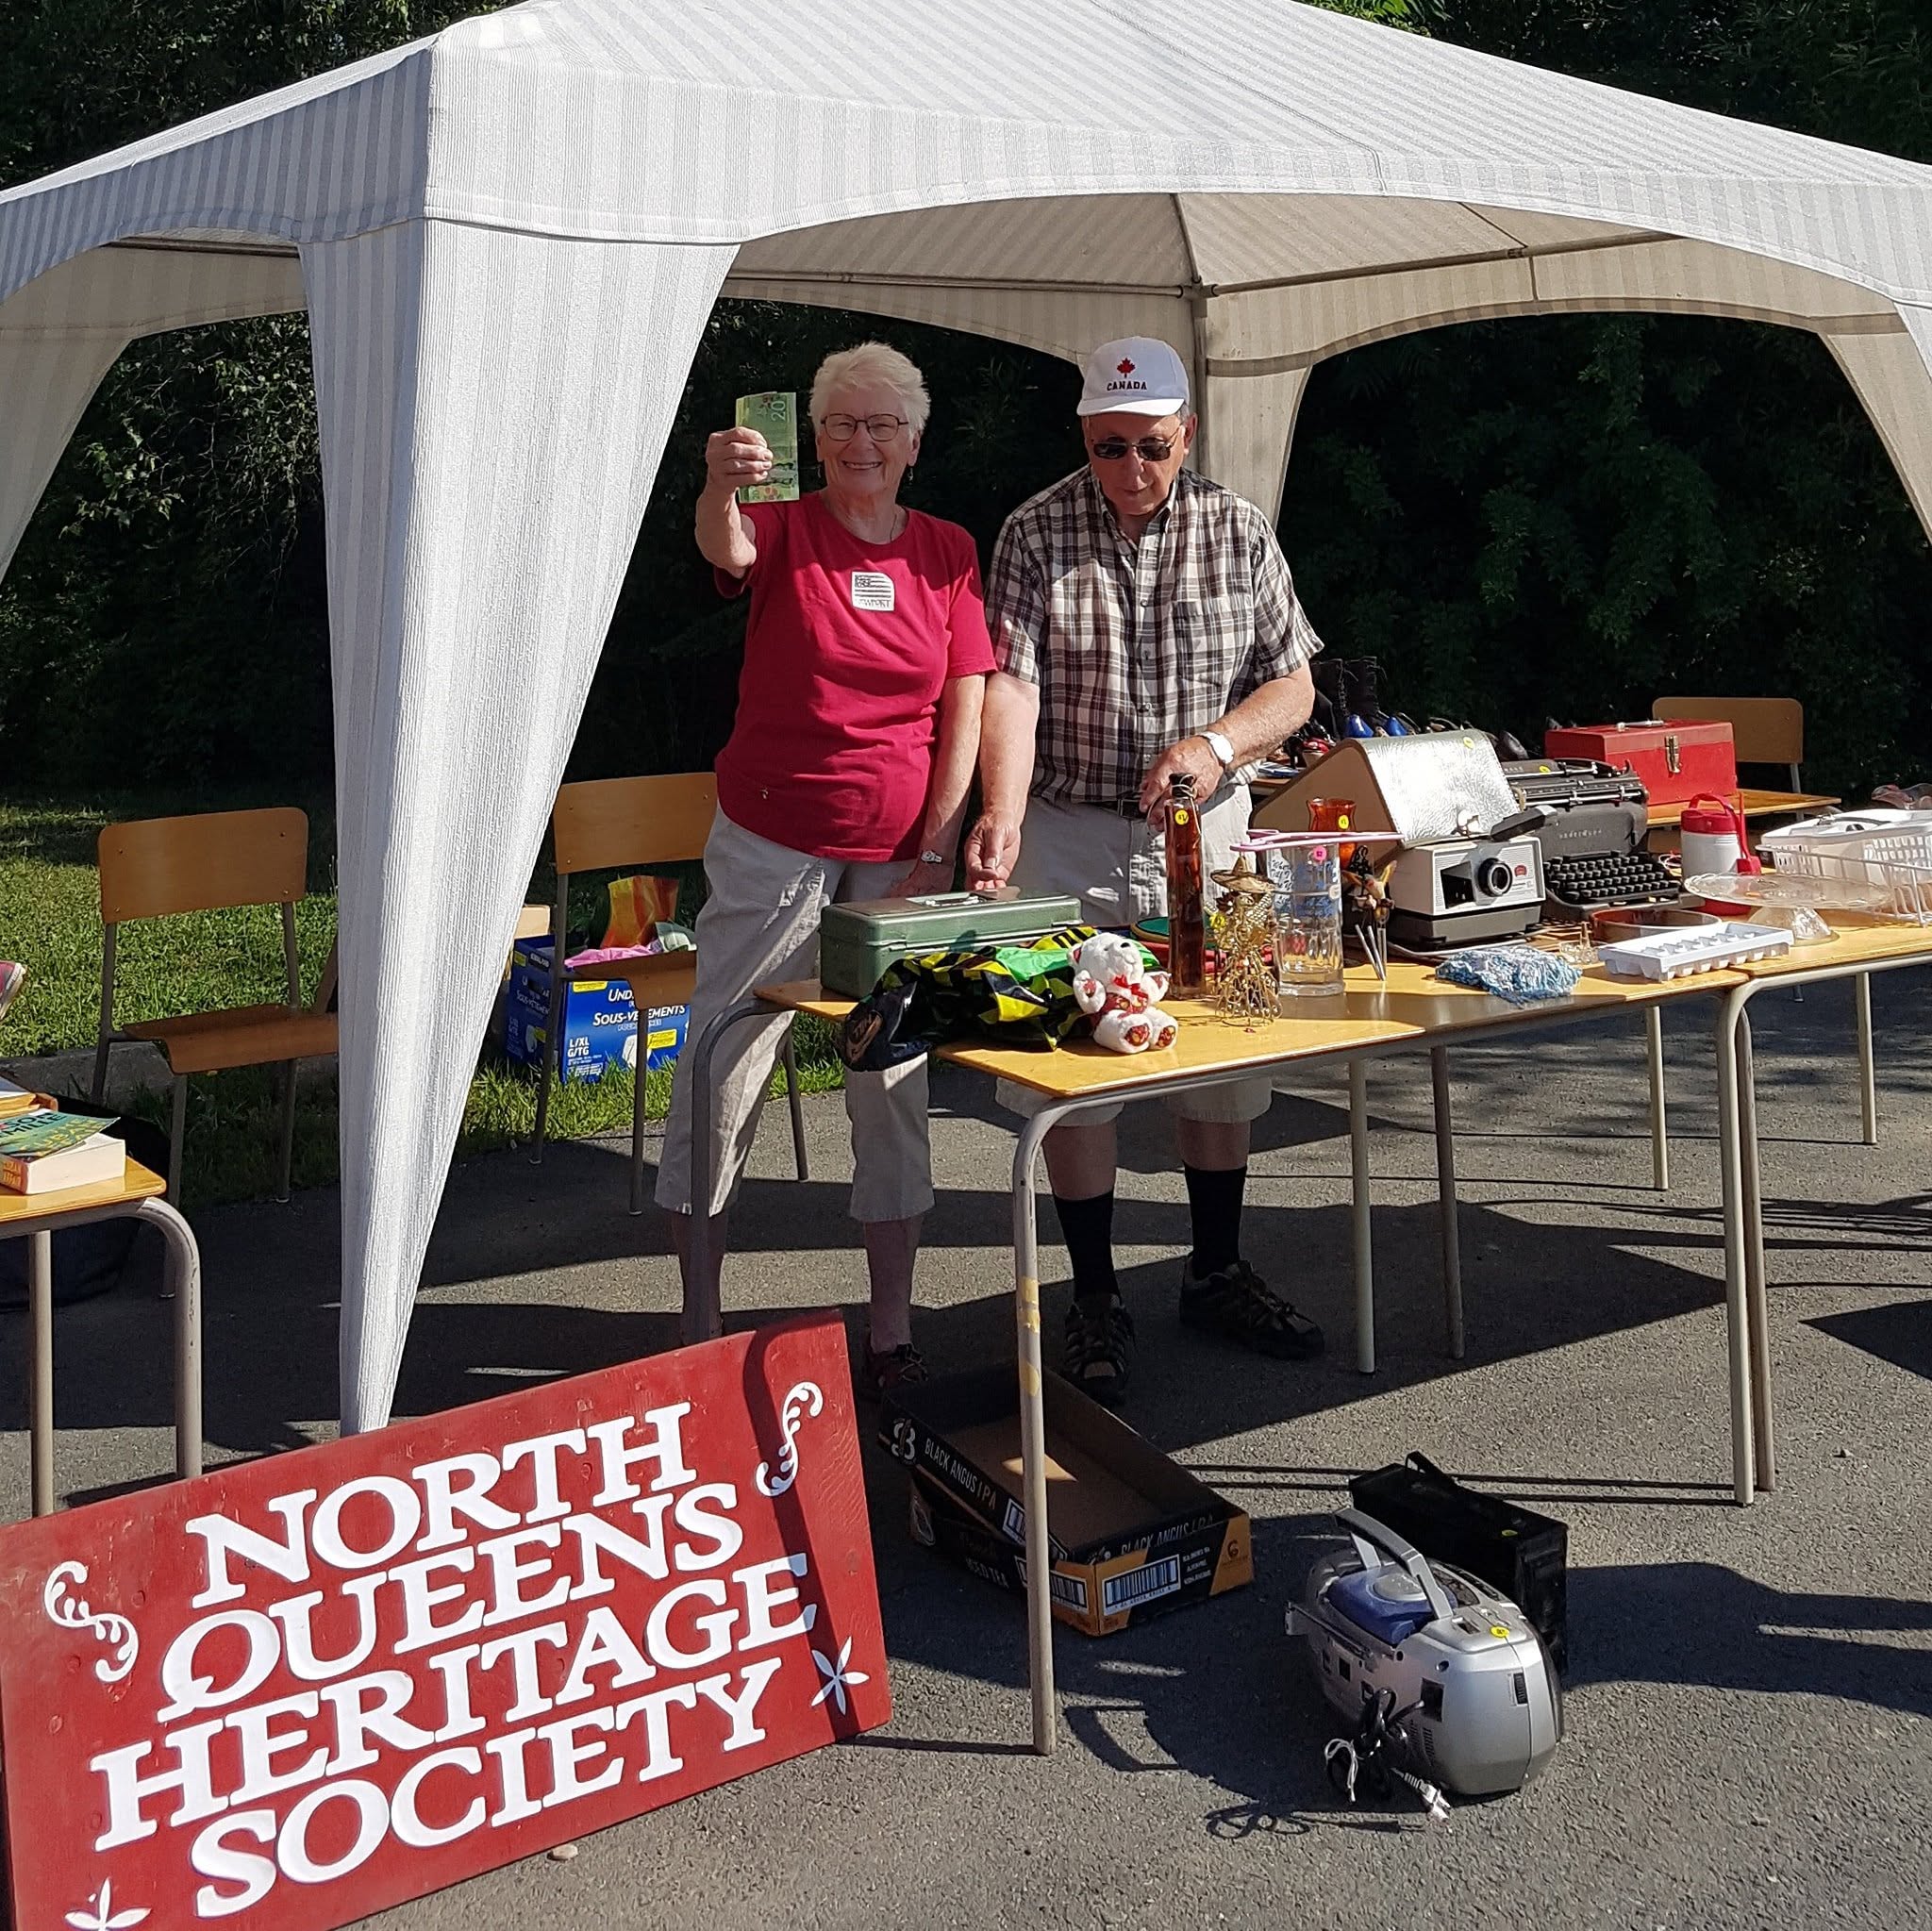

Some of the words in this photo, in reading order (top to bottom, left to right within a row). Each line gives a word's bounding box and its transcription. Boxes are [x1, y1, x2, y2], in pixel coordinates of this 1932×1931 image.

[1107, 381, 1147, 391] CANADA
[770, 400, 786, 422] 20
[608, 989, 634, 1002] UND
[592, 1005, 686, 1026] SOUS-VEEMENTS
[567, 1046, 590, 1057] G/TG
[569, 1037, 590, 1048] L/XL
[924, 1438, 951, 1472] BLACK
[950, 1459, 978, 1492] ANGUS
[976, 1481, 996, 1510] IPA
[187, 1402, 698, 1608] NORTH
[157, 1482, 744, 1723] QUEENS
[90, 1554, 816, 1852] HERITAGE
[191, 1657, 782, 1920] SOCIETY
